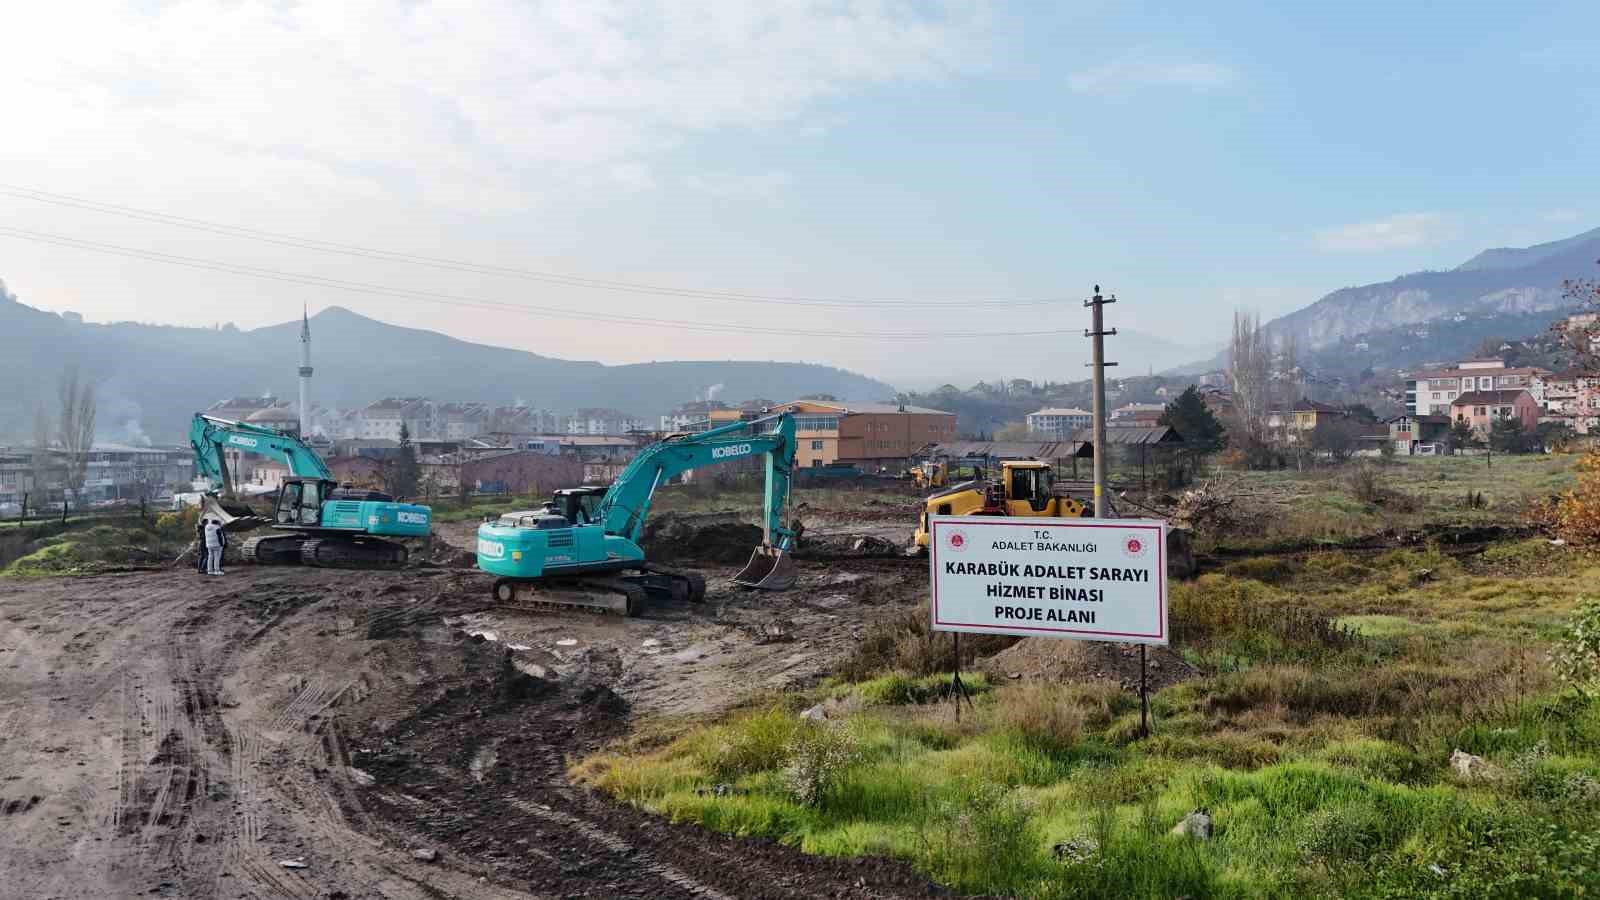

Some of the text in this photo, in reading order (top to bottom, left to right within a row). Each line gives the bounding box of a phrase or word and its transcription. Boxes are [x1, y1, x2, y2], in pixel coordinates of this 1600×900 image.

[711, 443, 751, 459] KOBELCO
[1033, 530, 1053, 540] T.C.
[991, 541, 1097, 553] ADALET BAKANLIĞI
[945, 560, 1149, 582] KARABÜK ADALET SARAYI
[986, 582, 1104, 602] HİZMET BİNASI
[994, 606, 1096, 624] PROJE ALANI
